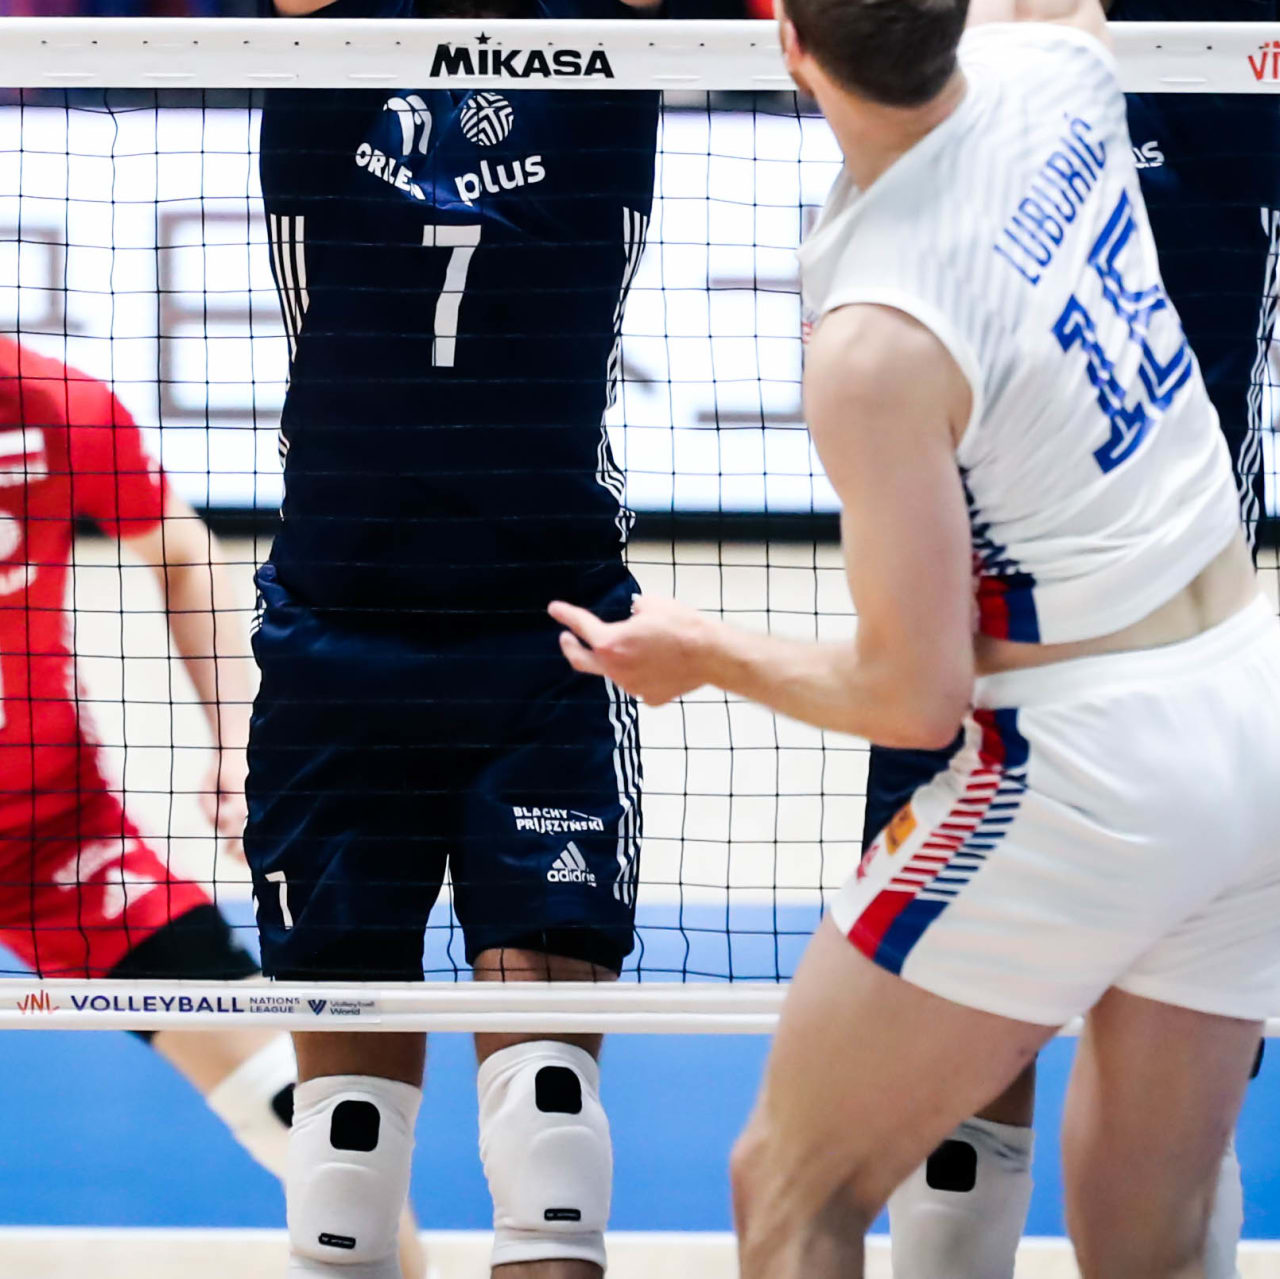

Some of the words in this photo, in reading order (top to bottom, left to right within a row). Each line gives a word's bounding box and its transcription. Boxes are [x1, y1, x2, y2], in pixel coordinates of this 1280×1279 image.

[429, 42, 615, 79] MIKASA
[454, 155, 546, 207] plus
[422, 224, 482, 368] 7
[1052, 188, 1193, 474] 15
[512, 806, 568, 819] BLACHY
[264, 870, 294, 930] 7
[16, 989, 60, 1014] VNL
[70, 995, 245, 1013] VOLLEYBALL
[249, 996, 301, 1005] NATIONS
[249, 1006, 295, 1014] LEAGUE
[330, 1007, 361, 1016] World
